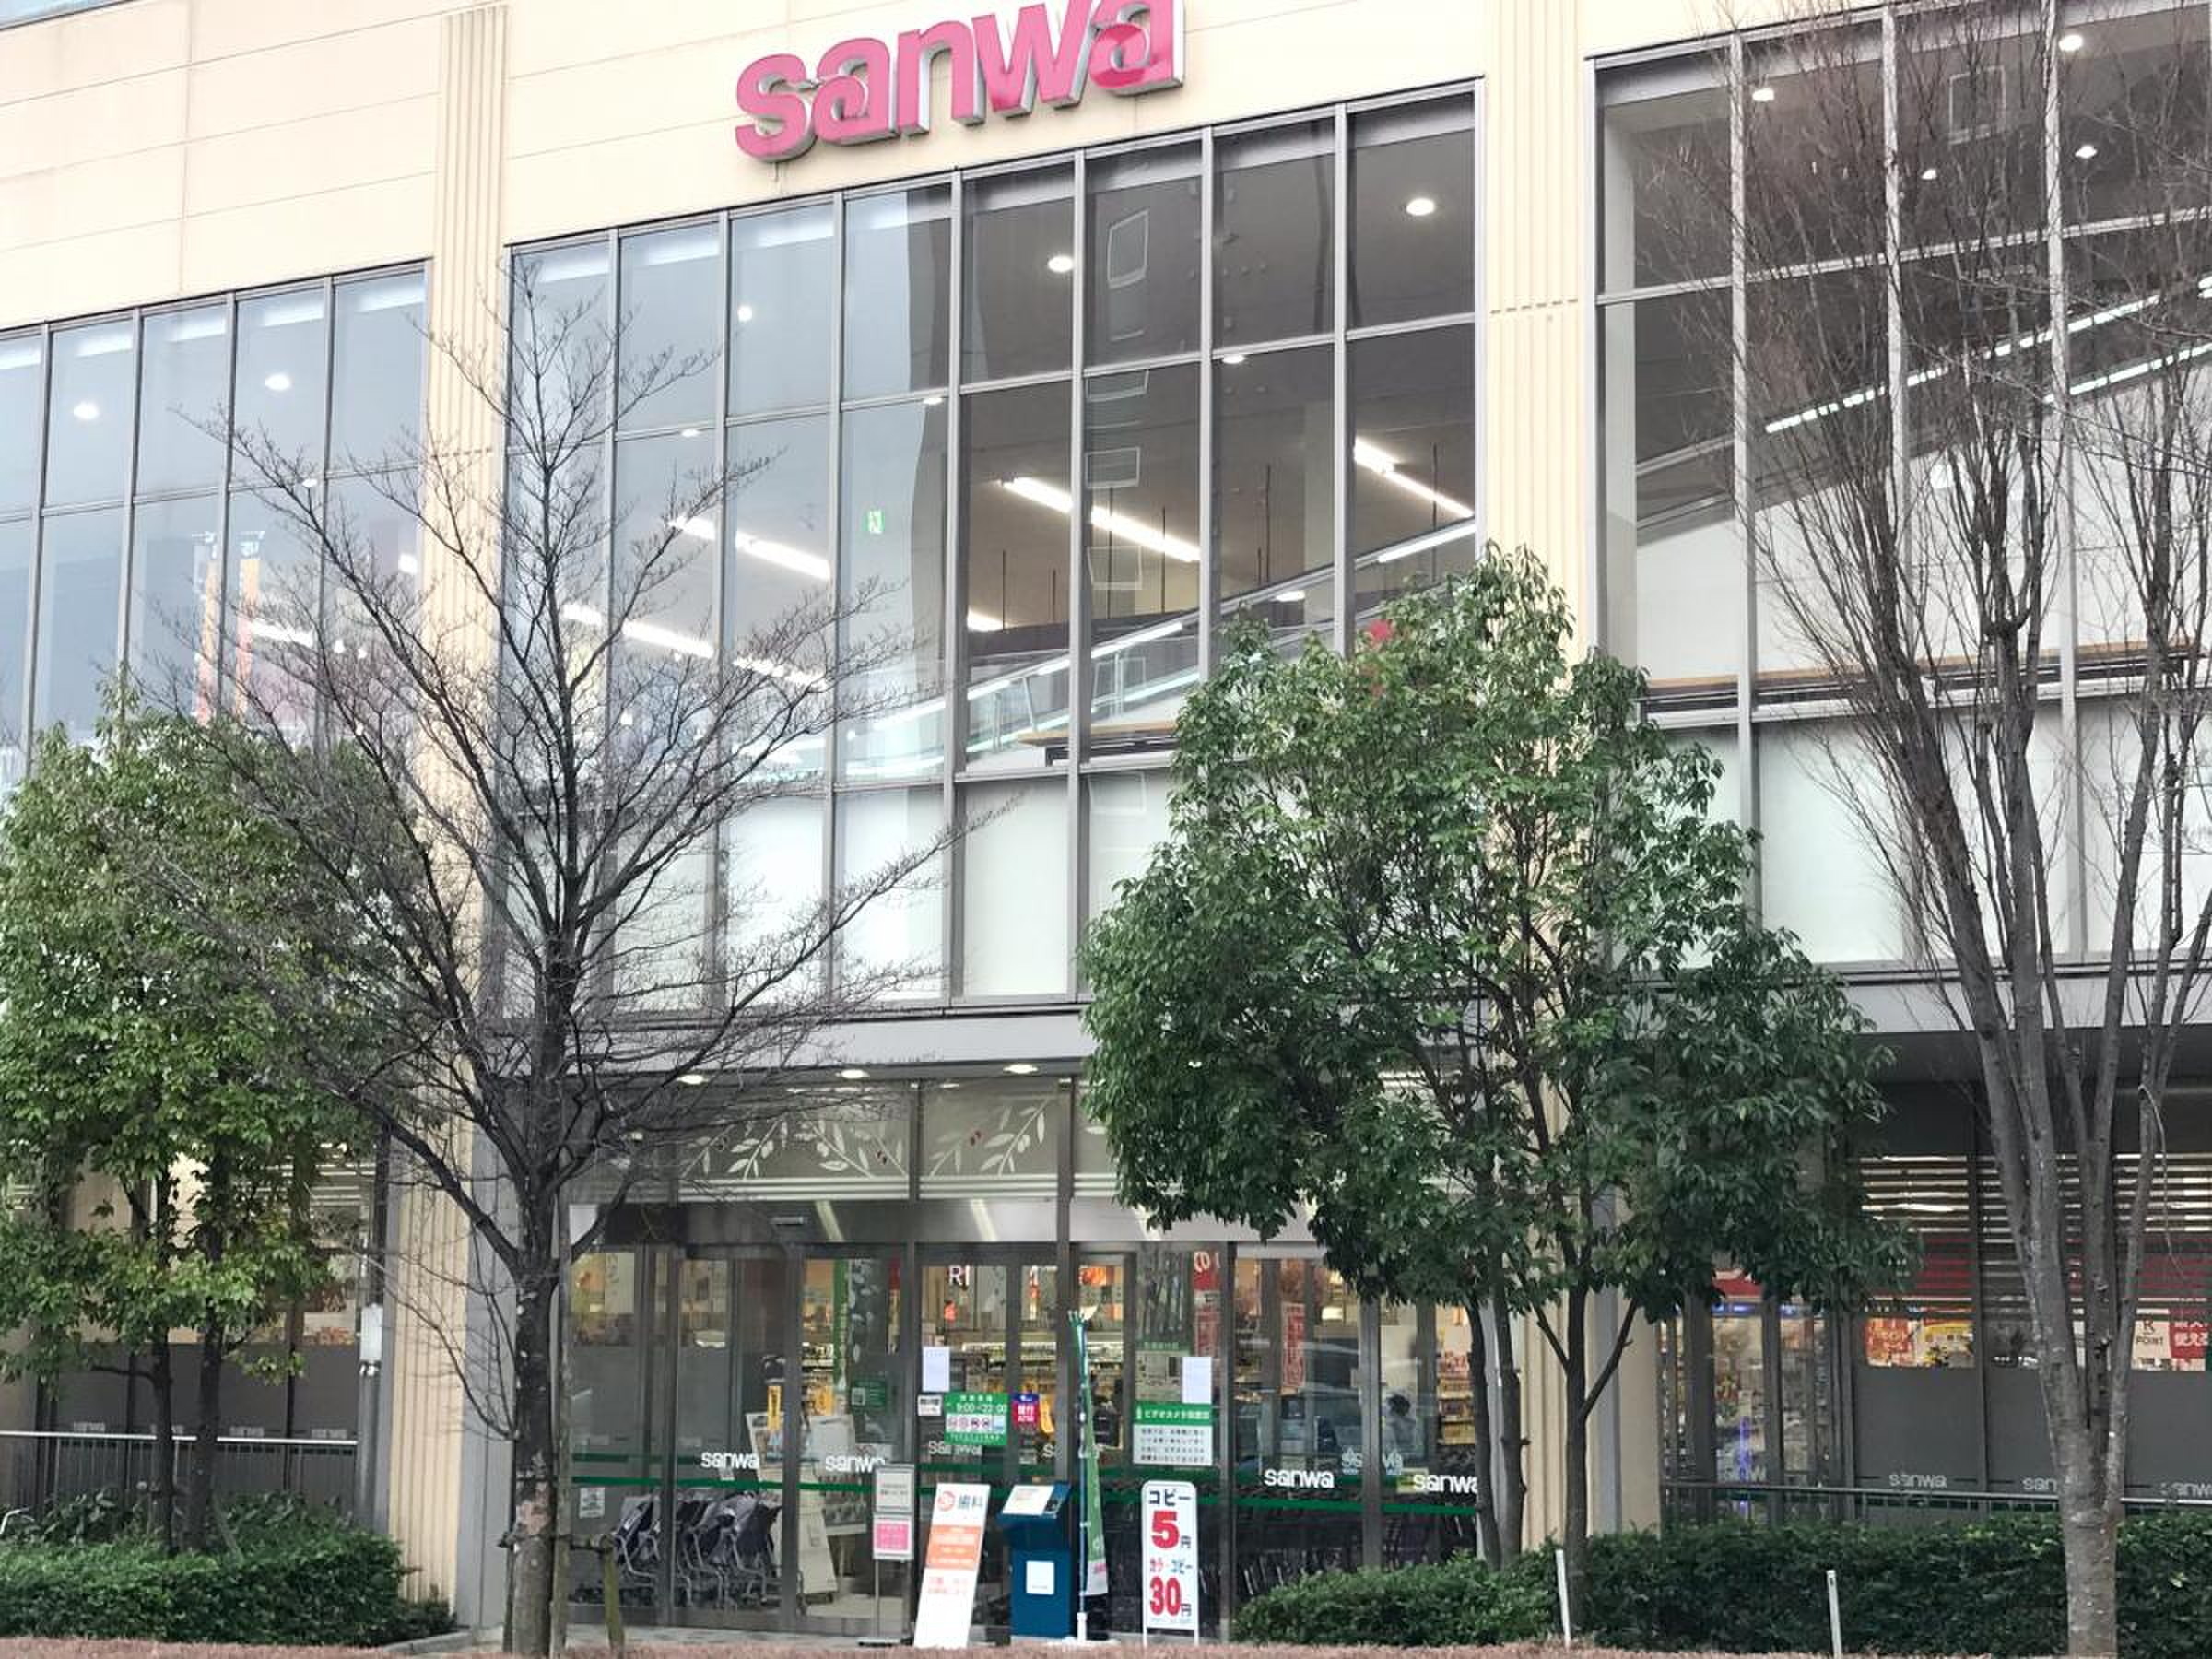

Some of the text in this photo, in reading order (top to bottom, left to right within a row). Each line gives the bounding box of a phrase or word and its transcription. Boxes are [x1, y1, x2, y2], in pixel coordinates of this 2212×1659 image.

[735, 0, 1184, 163] sanwa
[700, 1451, 760, 1470] sanwa
[1264, 1468, 1335, 1489] sanwa
[1888, 1472, 1947, 1488] sanwa
[2022, 1477, 2058, 1491] san
[1148, 1488, 1192, 1507] コピー
